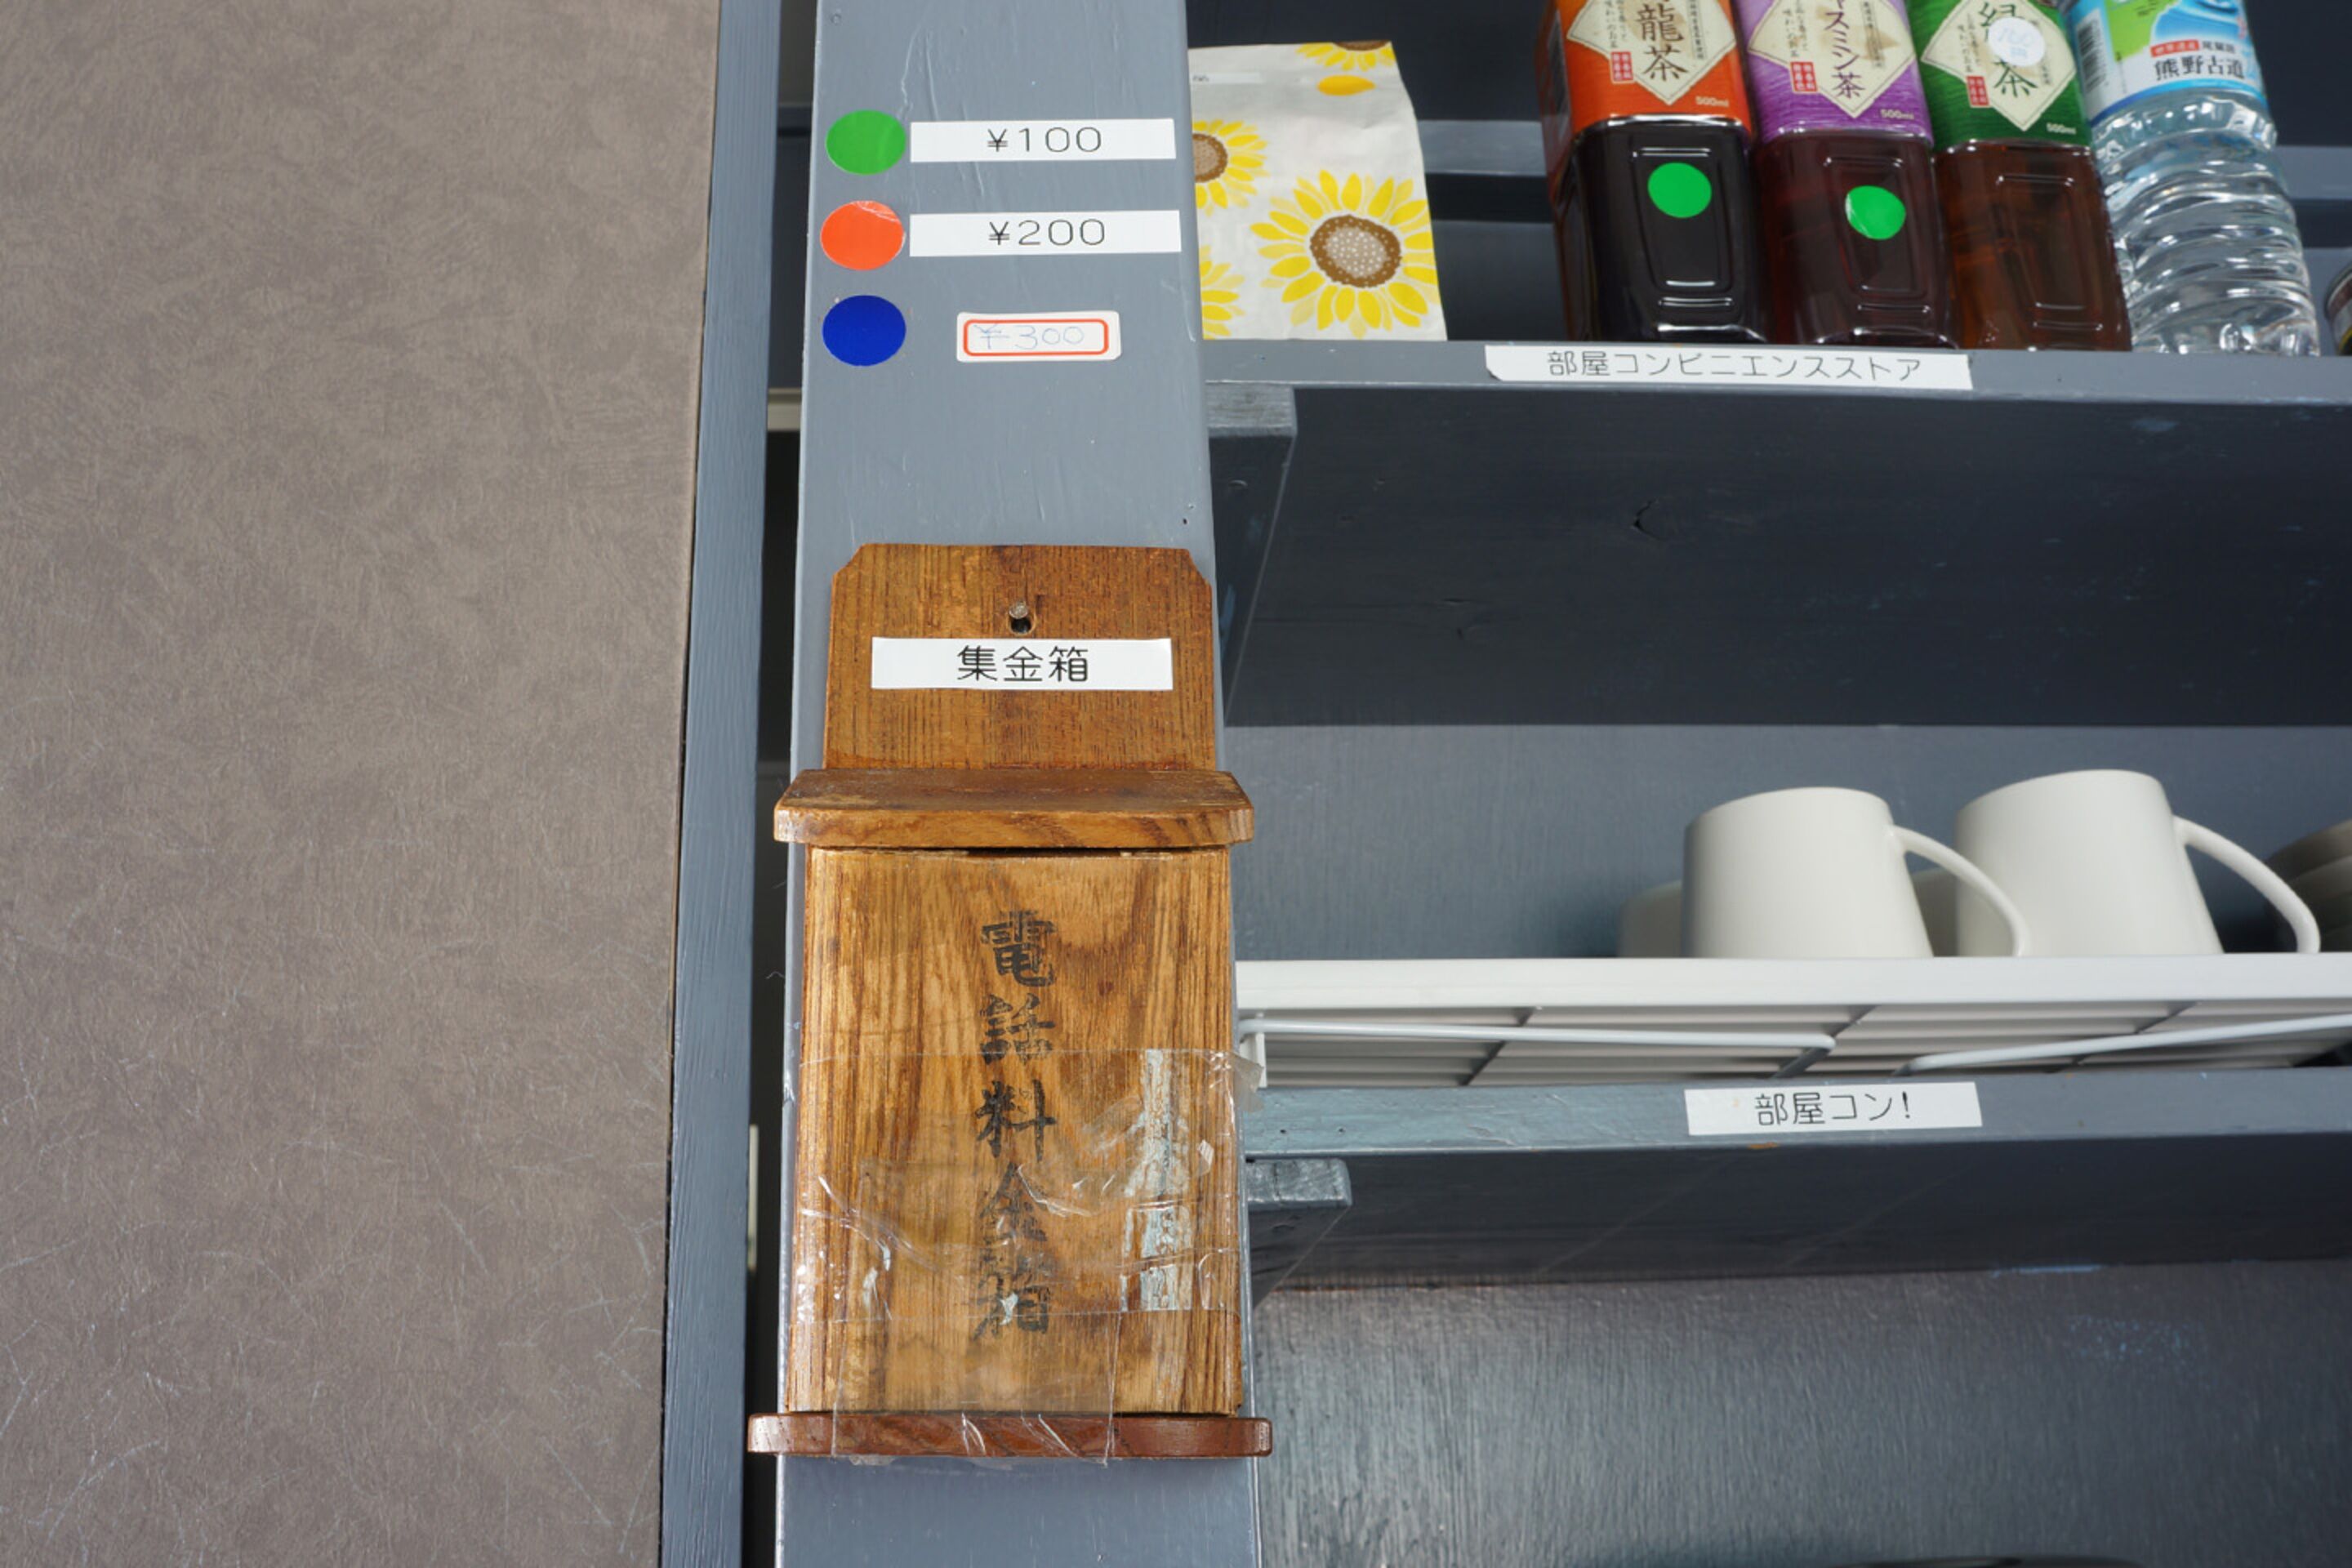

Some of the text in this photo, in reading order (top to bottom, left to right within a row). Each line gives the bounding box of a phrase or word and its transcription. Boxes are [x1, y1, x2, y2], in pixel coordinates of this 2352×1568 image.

[1637, 0, 1689, 81] 龍茶
[2154, 55, 2245, 81] 熊野古道
[1695, 96, 1730, 107] 500ml
[1880, 108, 1915, 119] 500ml
[987, 126, 1102, 154] ¥100
[988, 218, 1107, 247] ¥200
[973, 323, 1085, 351] ¥300
[1547, 350, 1922, 382] 部屋コンビニエンスストア
[956, 644, 1089, 683] 集金箱
[1754, 1090, 1912, 1126] 部屋コン!
